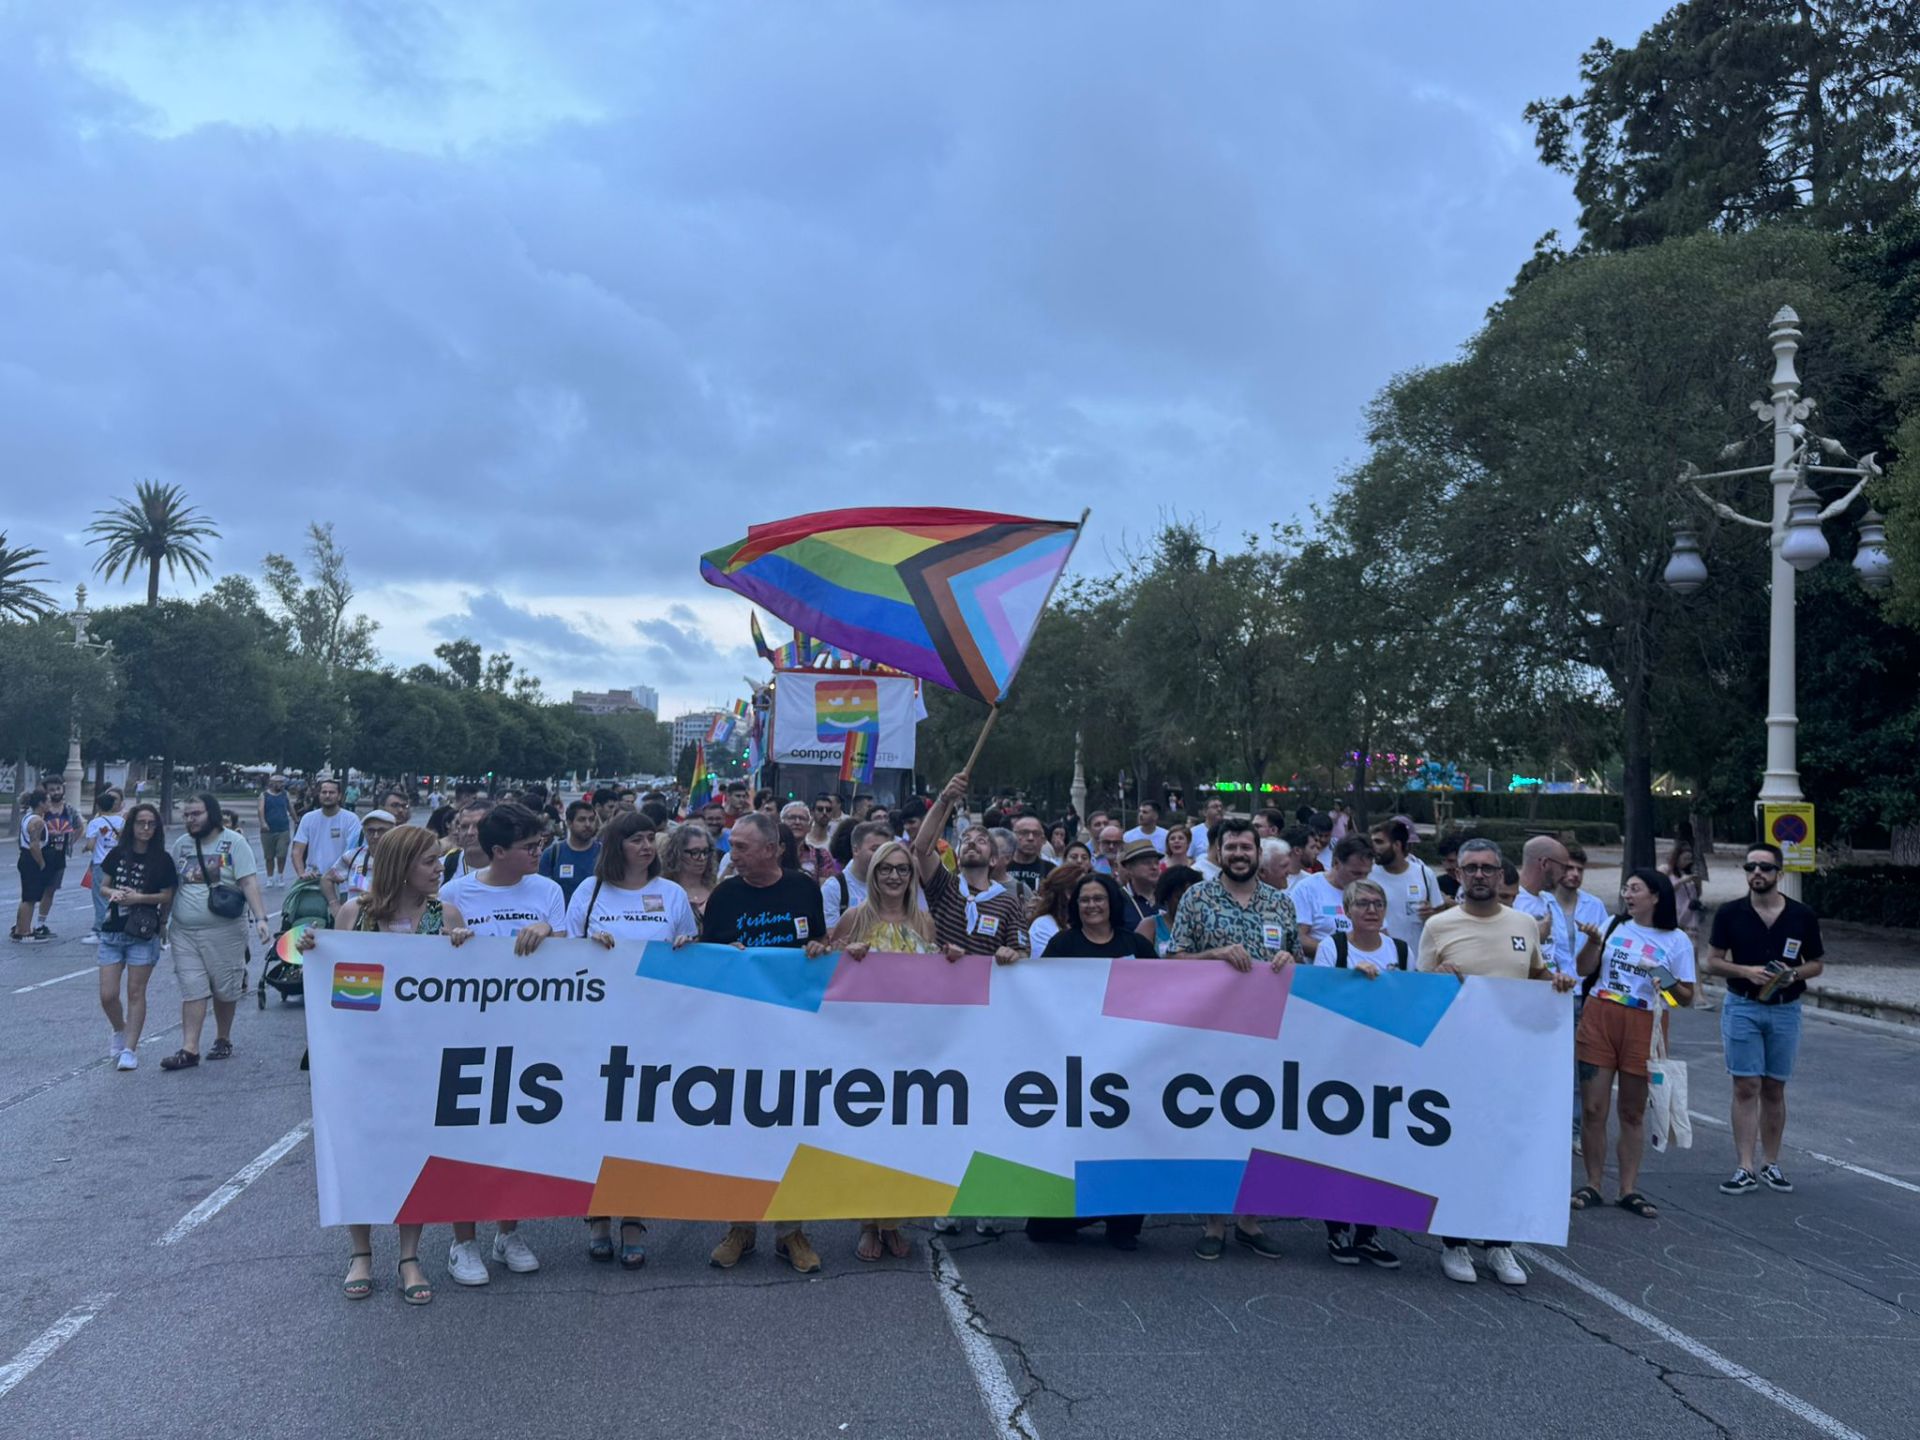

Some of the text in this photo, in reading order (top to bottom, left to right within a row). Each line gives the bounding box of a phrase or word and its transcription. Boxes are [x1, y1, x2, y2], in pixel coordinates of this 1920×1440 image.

[790, 748, 842, 764] compro
[394, 968, 607, 1014] compromís
[434, 1045, 1453, 1148] Els traurem els colors
